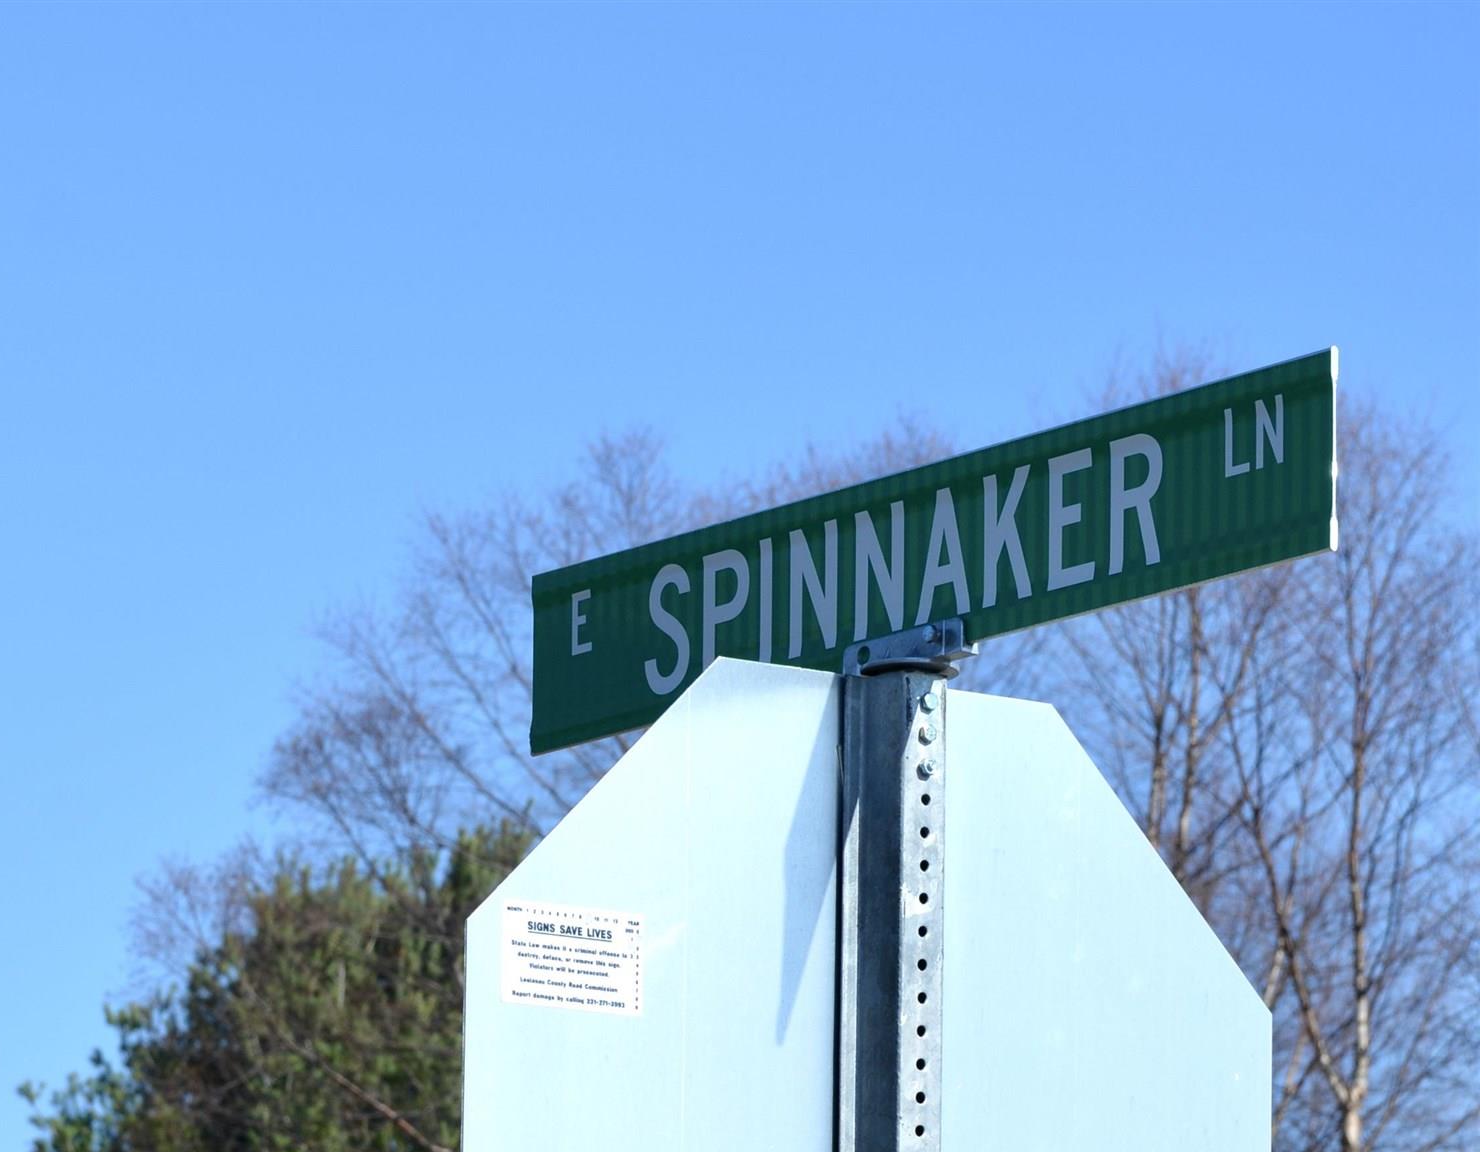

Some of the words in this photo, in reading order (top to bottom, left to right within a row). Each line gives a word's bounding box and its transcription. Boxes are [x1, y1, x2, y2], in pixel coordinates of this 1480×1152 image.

[571, 590, 592, 655] E
[645, 433, 1163, 696] SPINNAKER
[1224, 394, 1285, 478] LN
[527, 920, 555, 933] SIGNS
[560, 925, 583, 936] SAVE
[587, 928, 612, 939] LIVES
[599, 950, 620, 958] offense
[529, 963, 554, 971] Violators
[520, 976, 545, 984] Leelanau
[547, 979, 567, 988] County
[568, 981, 583, 989] Road
[584, 984, 618, 992] Commission
[565, 997, 584, 1005] calling
